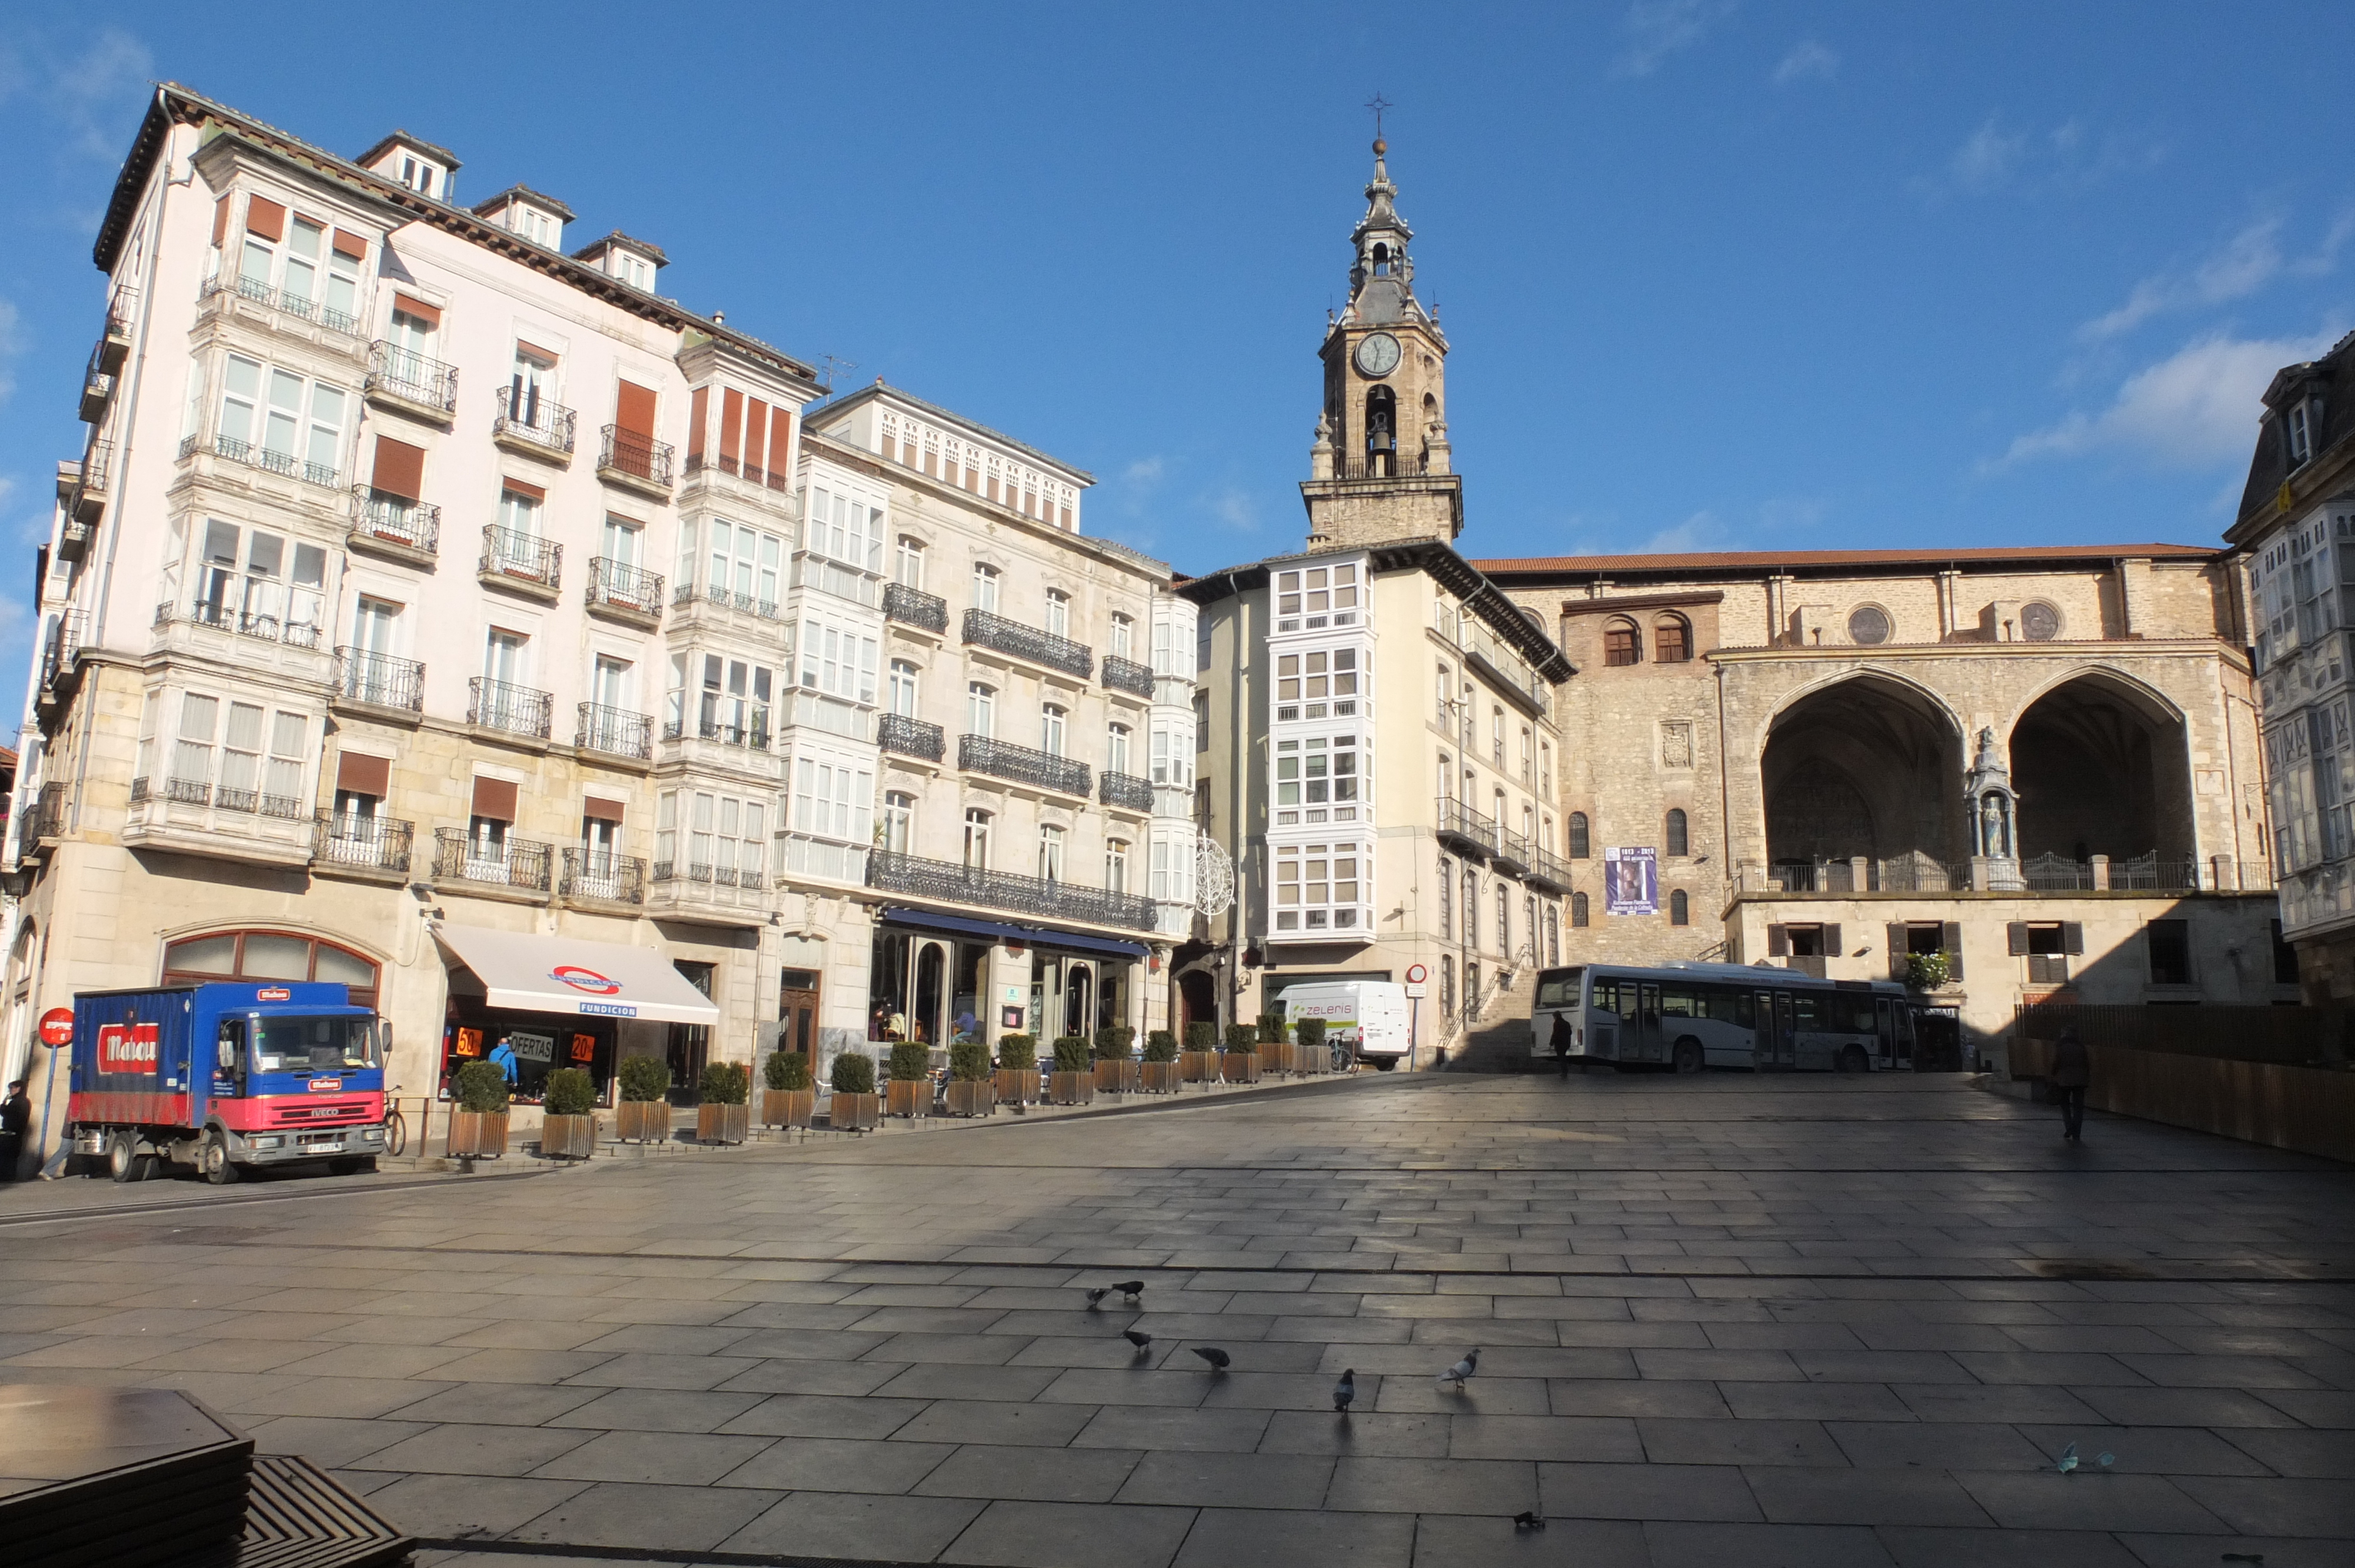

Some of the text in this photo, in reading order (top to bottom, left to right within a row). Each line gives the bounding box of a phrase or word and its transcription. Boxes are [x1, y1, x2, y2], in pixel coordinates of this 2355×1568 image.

[581, 1004, 636, 1016] FUNDICION
[107, 1035, 157, 1061] Mahou
[511, 1035, 552, 1058] OFERTAS
[311, 1109, 339, 1117] IVECO
